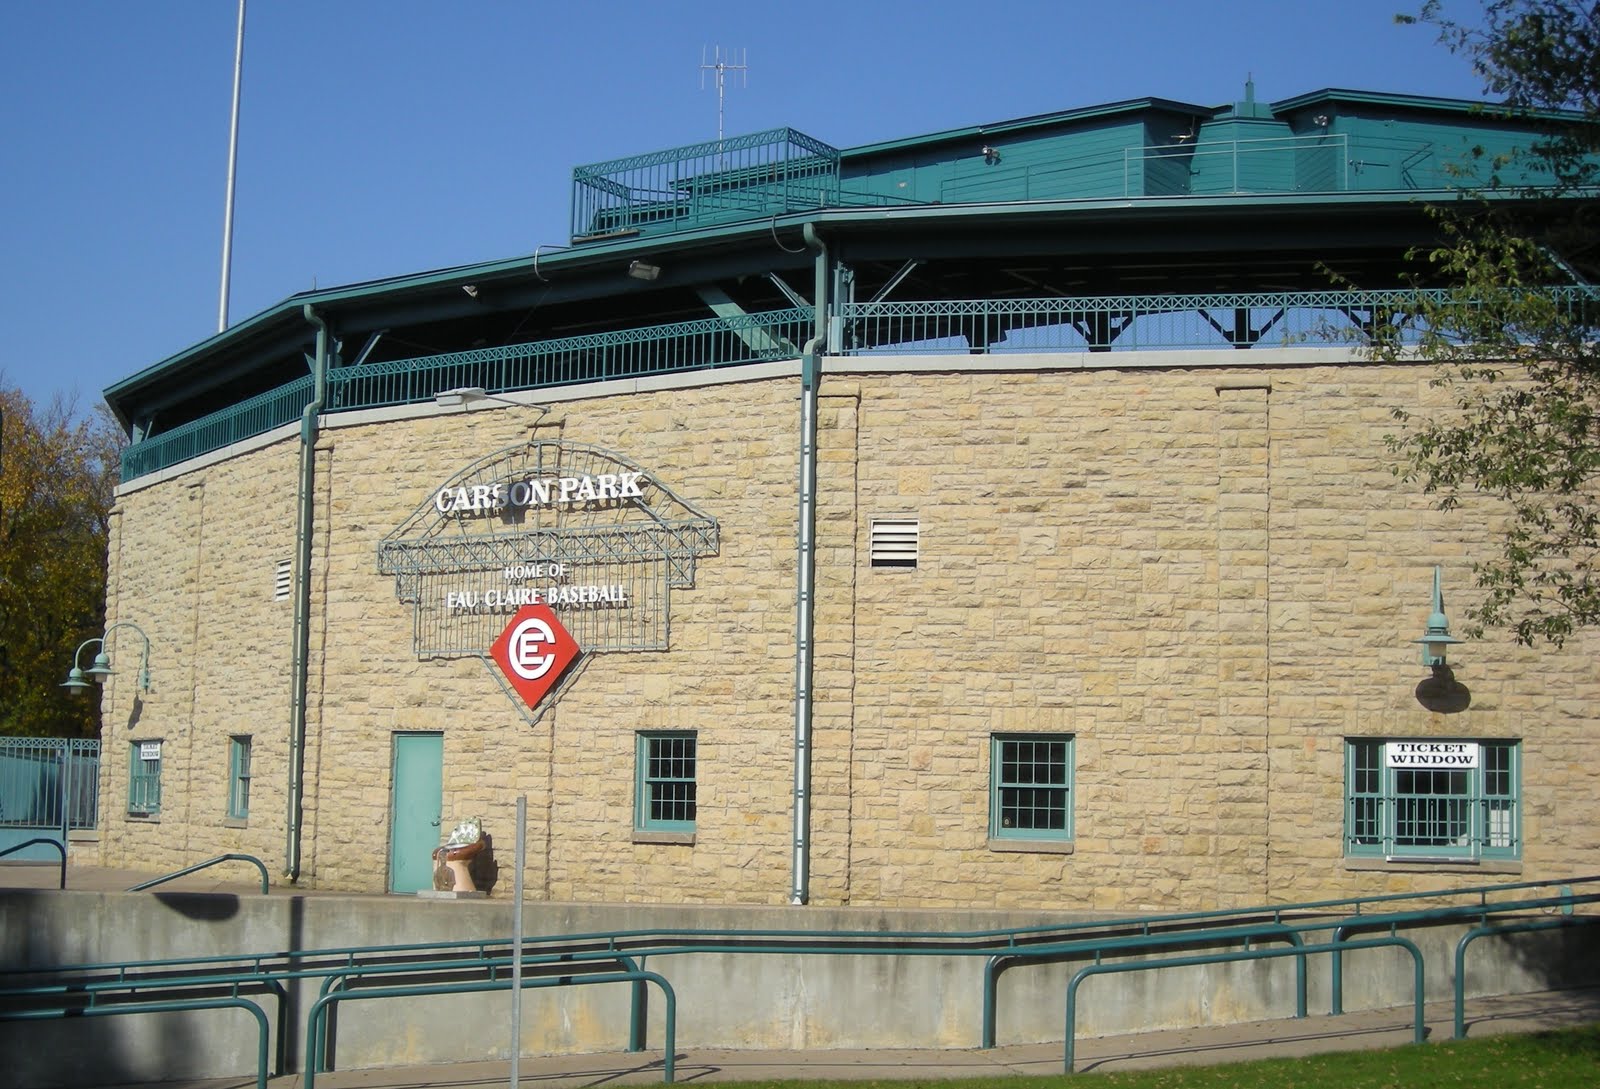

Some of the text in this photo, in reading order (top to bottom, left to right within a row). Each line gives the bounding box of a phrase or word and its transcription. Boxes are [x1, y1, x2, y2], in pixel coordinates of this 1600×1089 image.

[435, 471, 644, 512] CARSON PARK
[505, 563, 569, 579] HOME OF
[446, 584, 627, 608] EAU CLAIRE BASEBALL
[1397, 743, 1467, 753] TICKET
[1390, 755, 1474, 764] WINDOW
